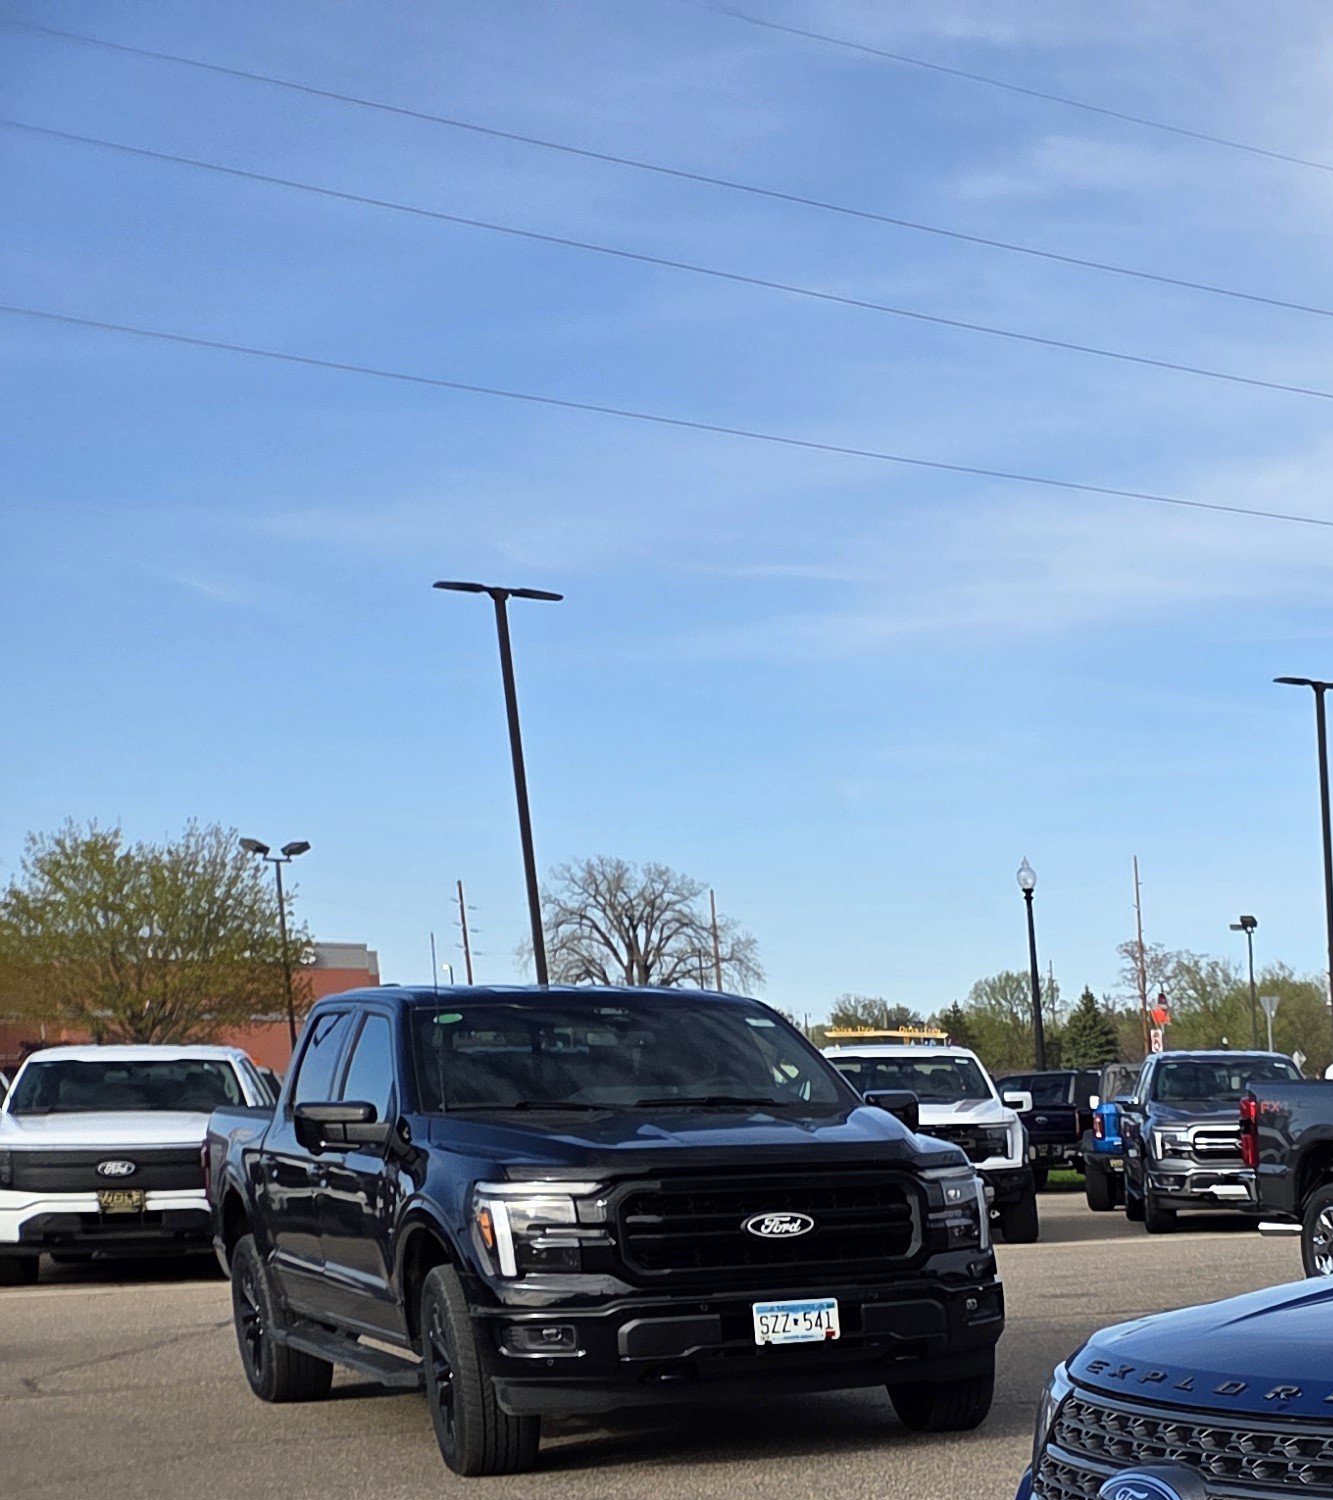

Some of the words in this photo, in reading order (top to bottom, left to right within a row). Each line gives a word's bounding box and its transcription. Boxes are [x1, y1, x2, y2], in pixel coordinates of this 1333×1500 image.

[761, 1216, 802, 1235] Ford
[760, 1313, 791, 1335] SZZ
[803, 1310, 834, 1332] 541
